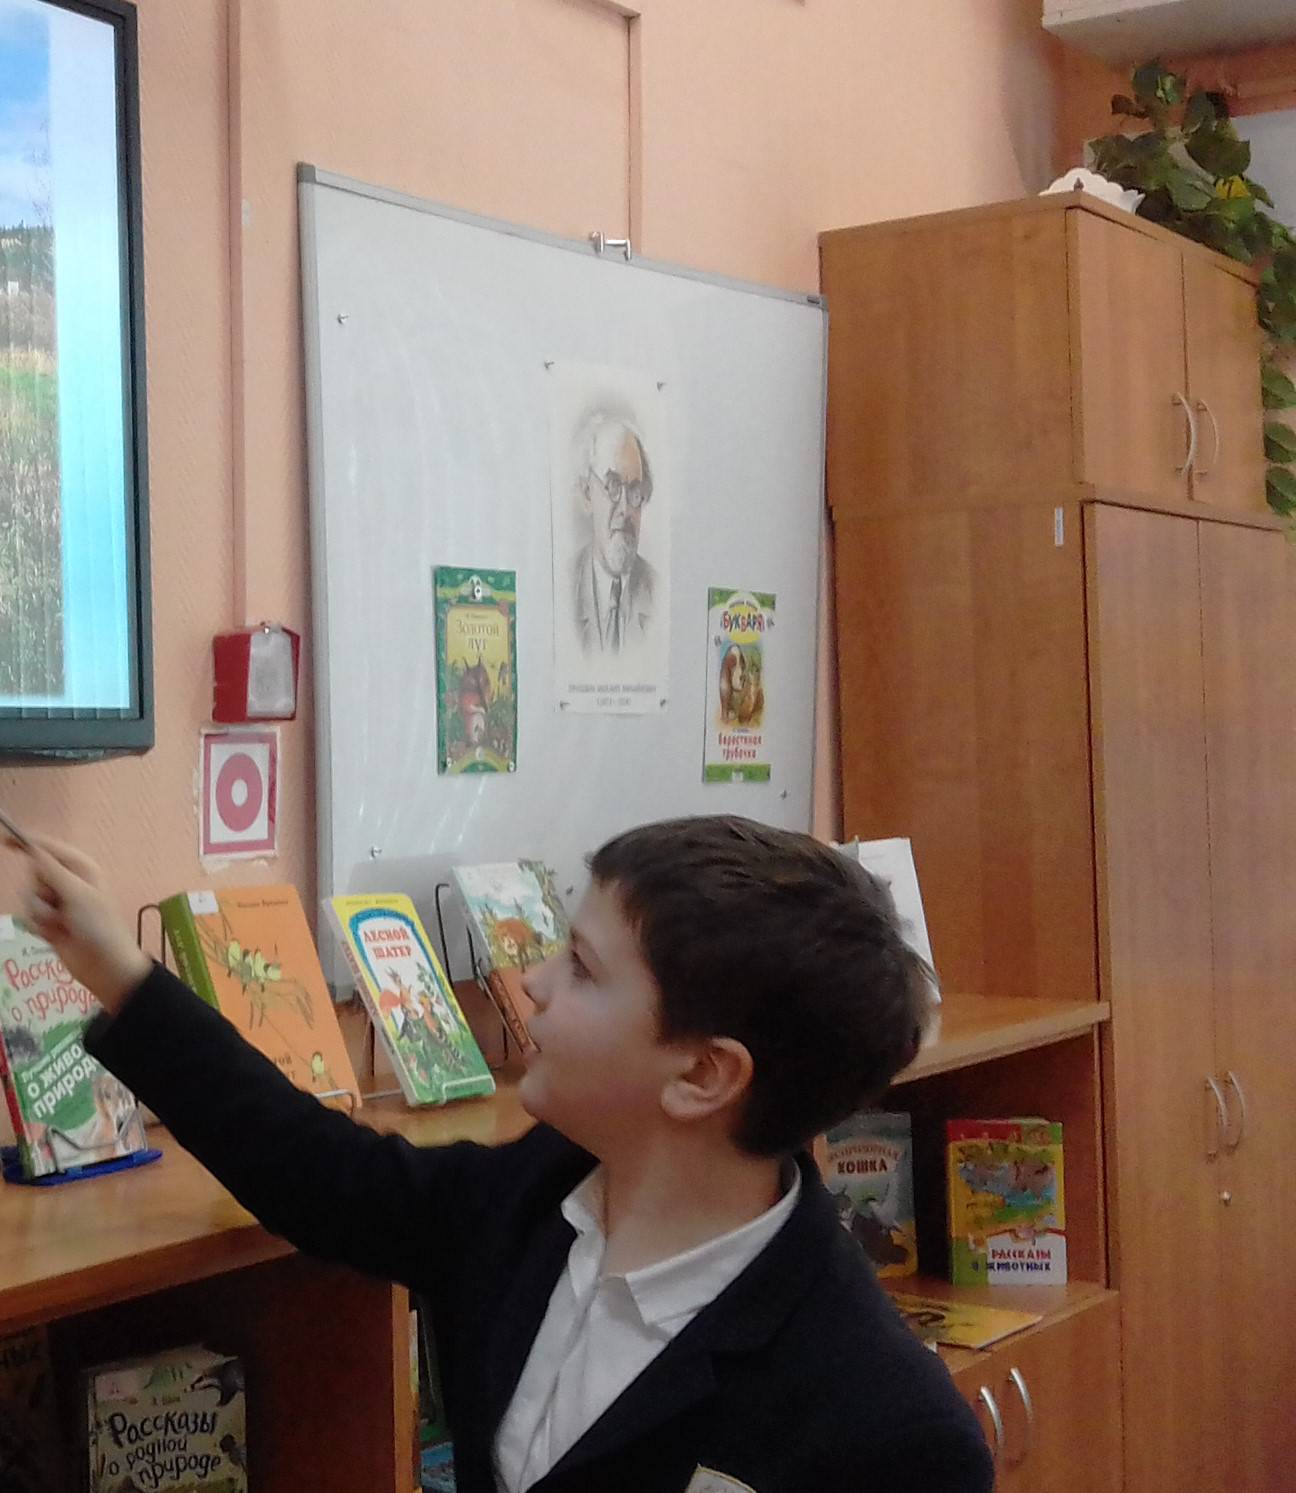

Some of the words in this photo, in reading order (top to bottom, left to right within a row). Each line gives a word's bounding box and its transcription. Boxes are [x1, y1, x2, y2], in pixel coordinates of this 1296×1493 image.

[363, 926, 410, 942] ЛЕСНОЙ
[5, 958, 68, 992] Расска
[39, 1043, 83, 1089] живо
[33, 1055, 98, 1118] природ
[837, 1158, 888, 1174] КОШКА
[991, 1249, 1051, 1260] РАССКАЗЫ
[109, 1410, 216, 1447] Рассказы
[108, 1461, 120, 1475] о
[126, 1436, 187, 1470] родной
[137, 1453, 221, 1488] природе
